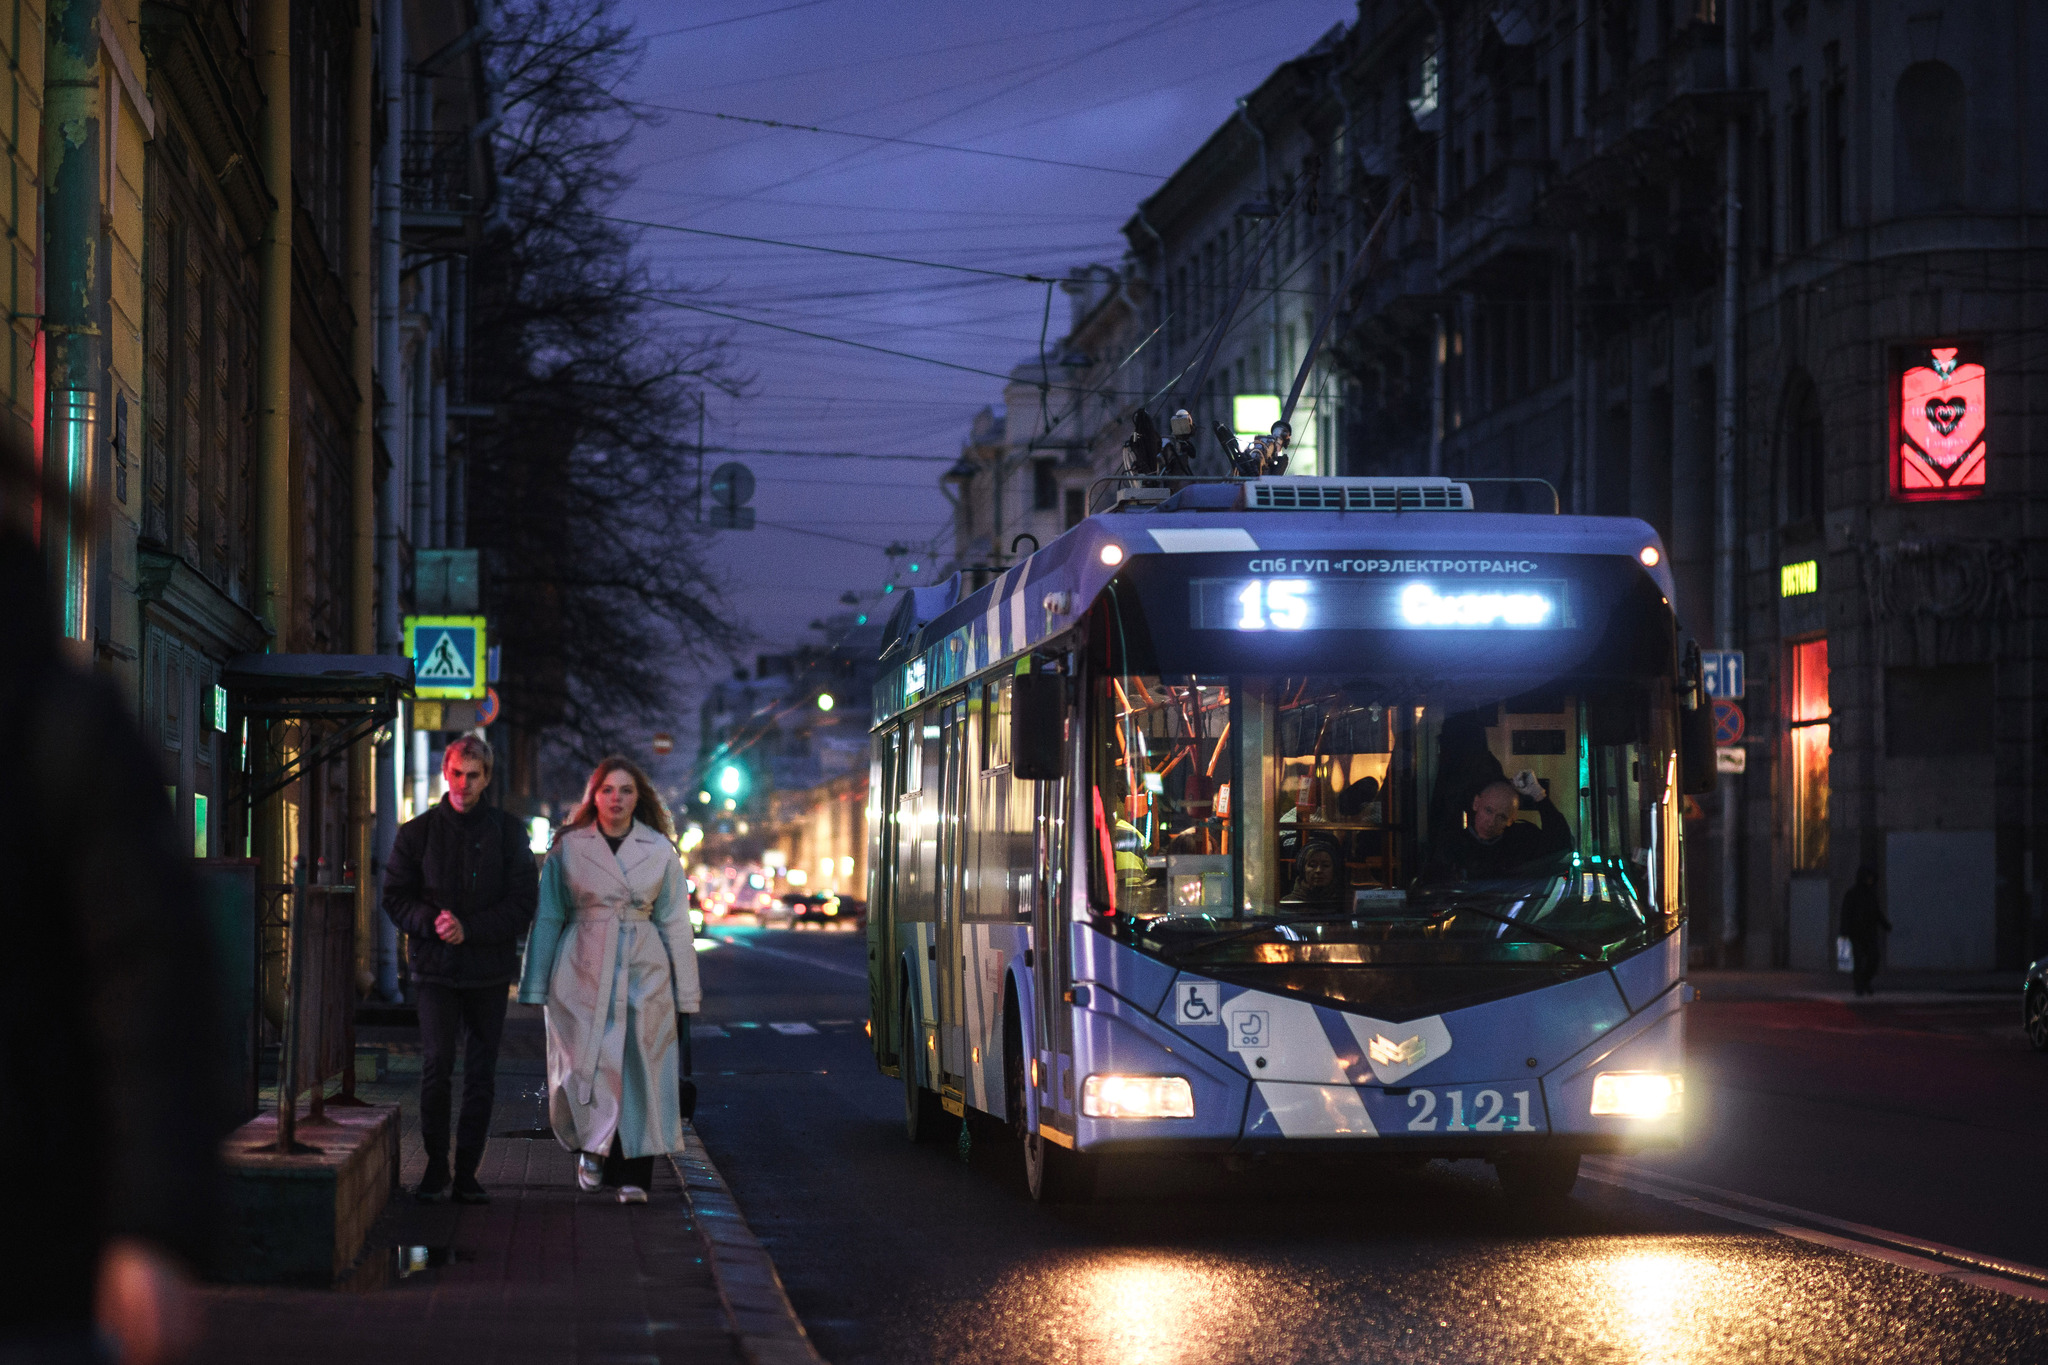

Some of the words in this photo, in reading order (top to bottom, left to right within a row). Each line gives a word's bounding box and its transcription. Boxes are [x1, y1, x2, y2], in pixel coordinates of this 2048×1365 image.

[1248, 558, 1287, 573] СПб
[1291, 558, 1330, 573] ГУП
[1333, 558, 1539, 574] «ГОРЭЛЕКТРОТРАНС»
[1238, 579, 1309, 630] 15
[1407, 1089, 1537, 1132] 2121
